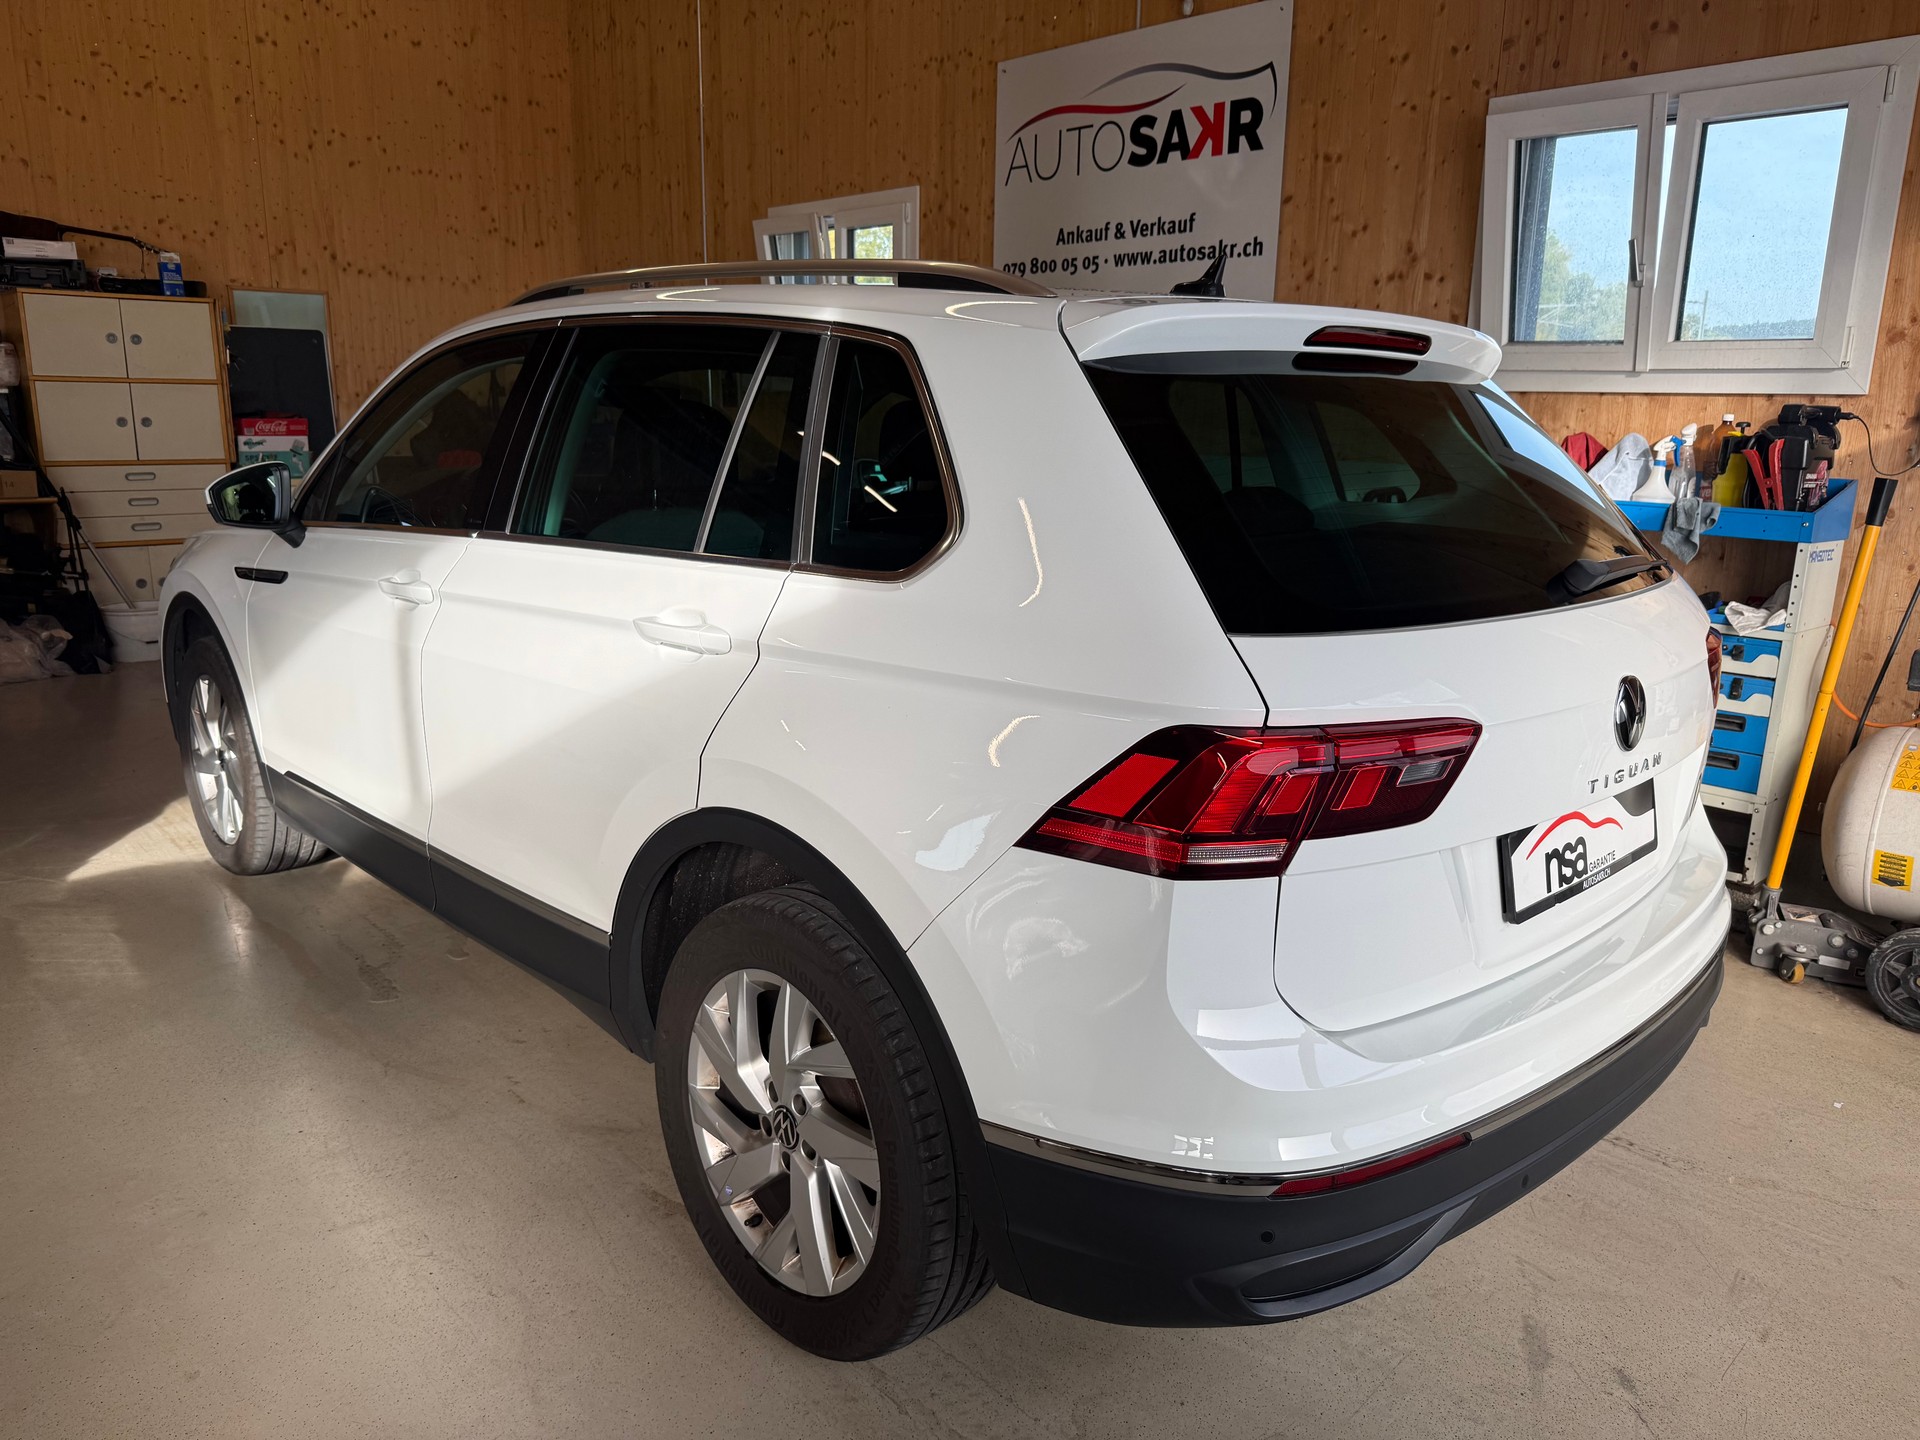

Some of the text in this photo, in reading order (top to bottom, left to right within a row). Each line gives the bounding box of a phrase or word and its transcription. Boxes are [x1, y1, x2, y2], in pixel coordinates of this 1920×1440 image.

[1056, 212, 1197, 246] Ankauf & Verkauf
[1003, 262, 1026, 278] 079
[1030, 257, 1057, 274] 800
[1062, 257, 1078, 275] 05
[1082, 255, 1100, 273] 05
[1113, 236, 1264, 267] www.autosakr.ch
[1587, 752, 1662, 794] TIGUAN
[1545, 836, 1588, 894] nsa
